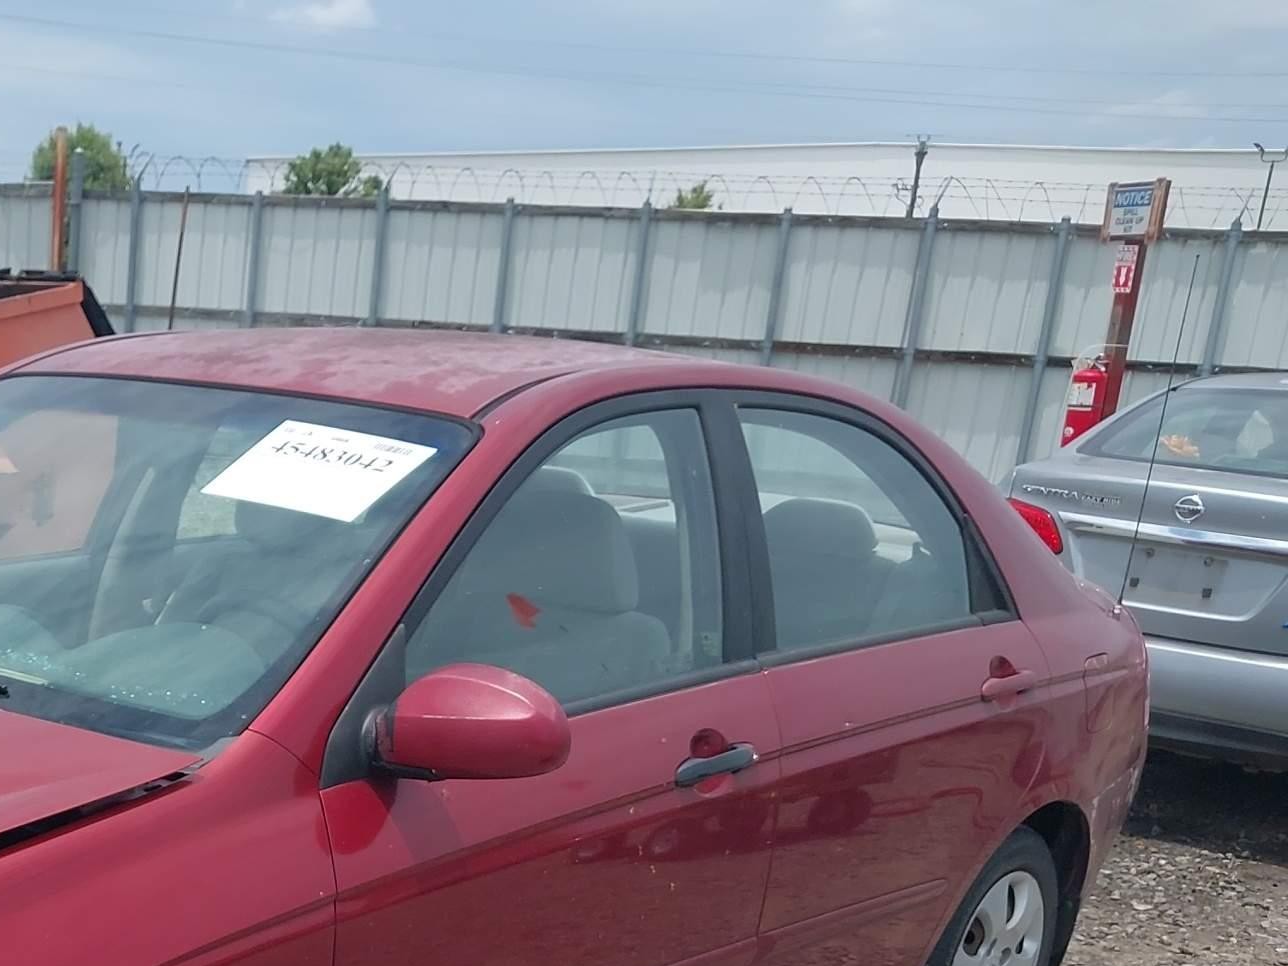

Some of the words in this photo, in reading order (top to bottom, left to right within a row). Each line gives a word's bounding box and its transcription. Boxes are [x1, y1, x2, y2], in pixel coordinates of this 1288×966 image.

[1116, 191, 1151, 205] NOTICE
[1115, 216, 1134, 225] CLEAN
[1135, 216, 1144, 225] UP
[272, 440, 394, 473] 45483042
